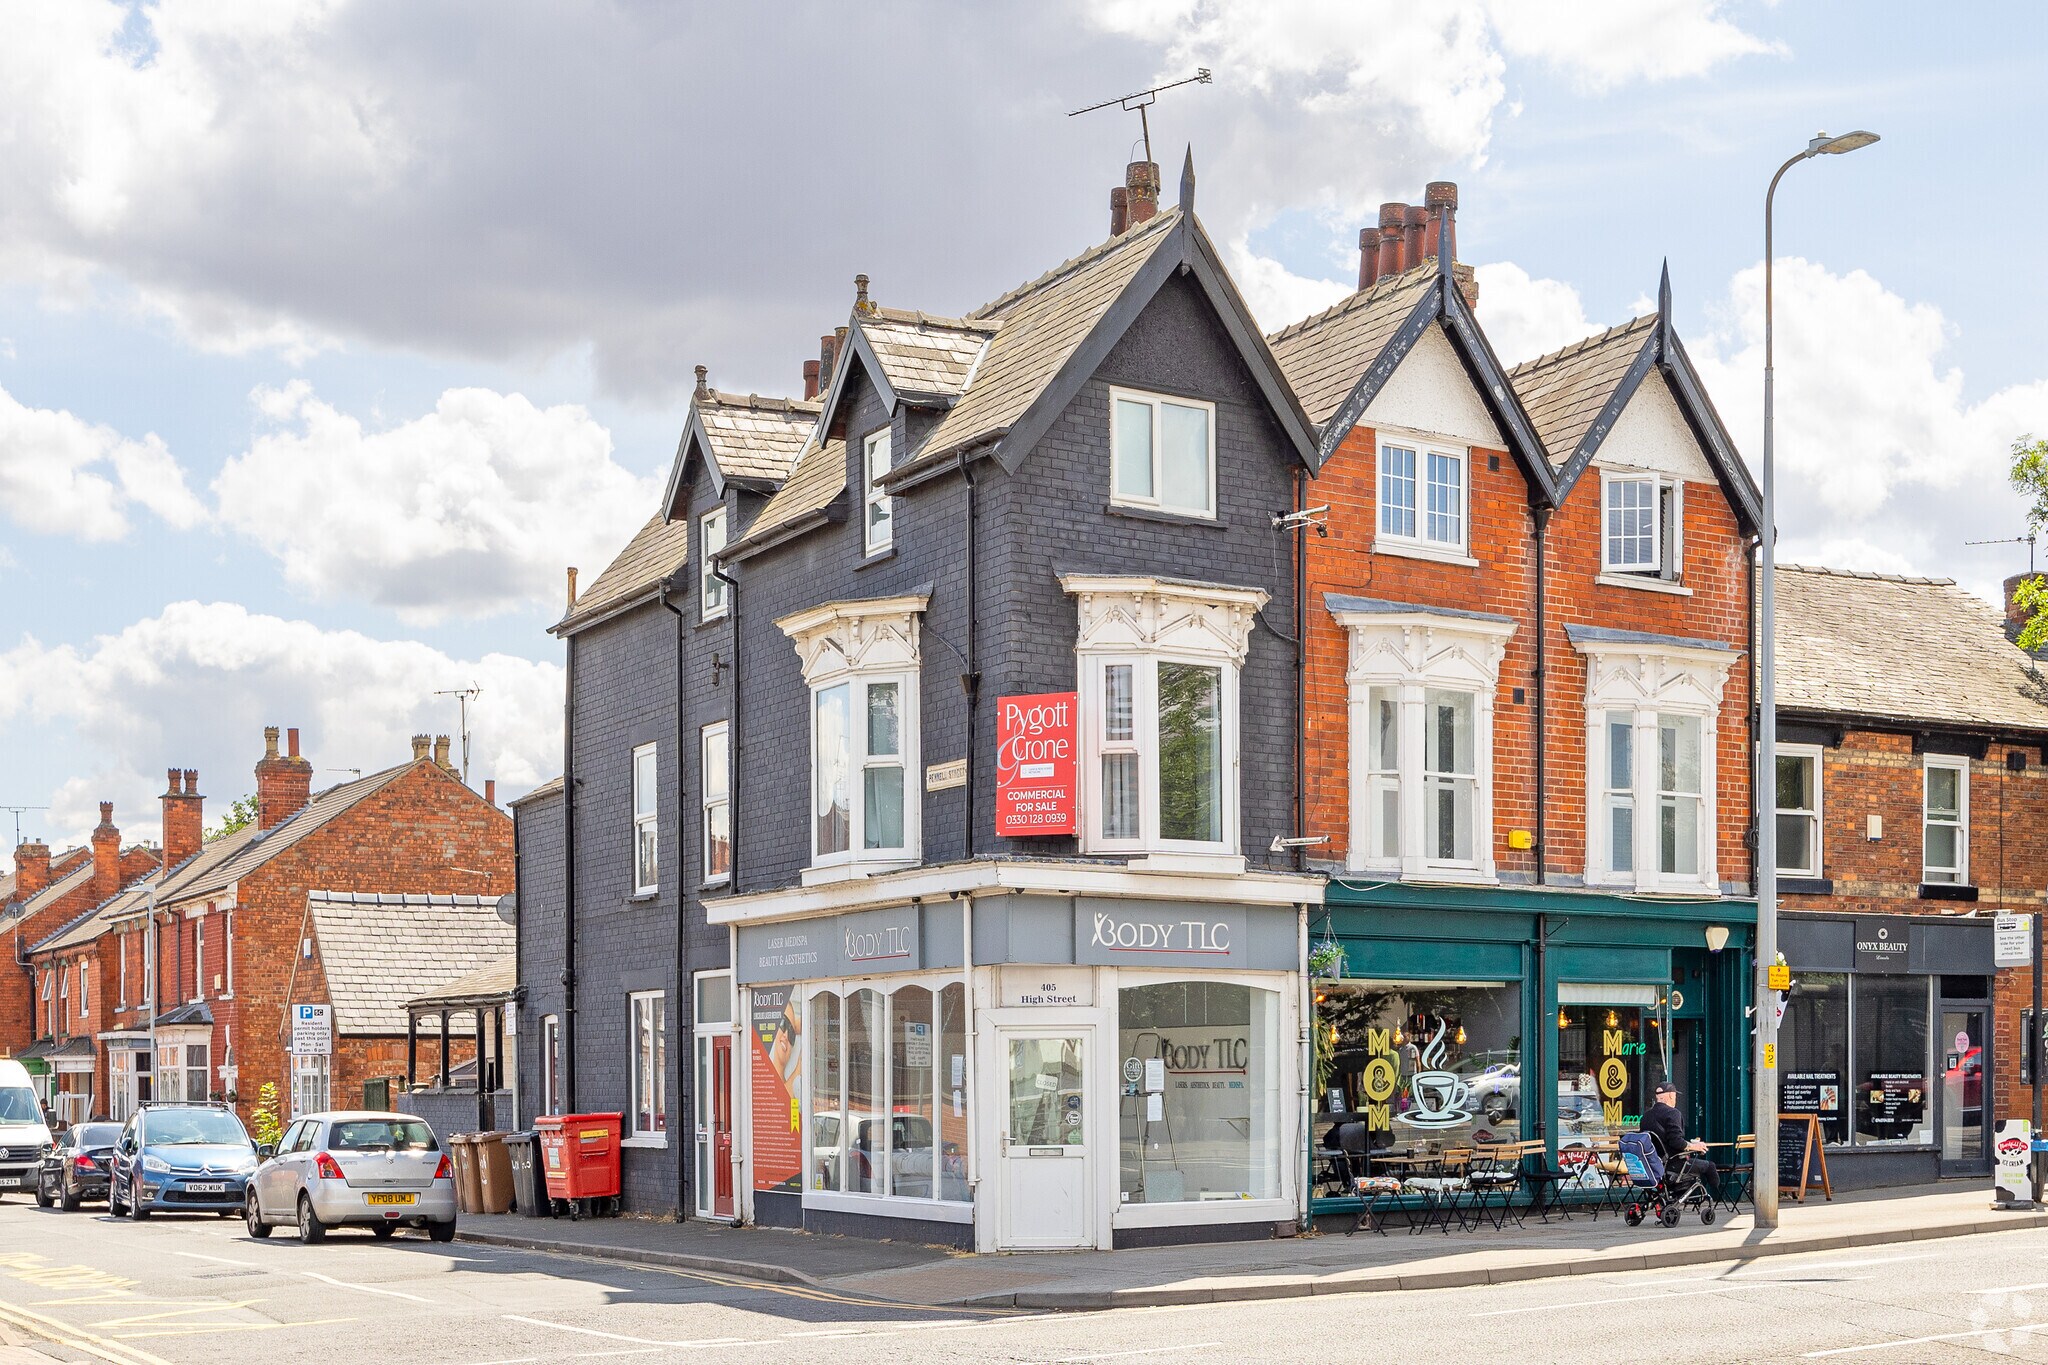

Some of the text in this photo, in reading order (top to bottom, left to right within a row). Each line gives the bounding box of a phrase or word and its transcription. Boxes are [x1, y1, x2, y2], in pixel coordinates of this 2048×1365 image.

[1006, 702, 1069, 735] Pygott
[1012, 736, 1069, 761] Crone
[1007, 790, 1066, 801] COMMERCIAL
[1016, 802, 1057, 812] FOR SALE
[1006, 813, 1067, 825] 0330 128 0939
[1091, 911, 1230, 950] BODY TLC
[767, 935, 808, 949] LASER MEDISPA
[844, 926, 911, 959] BODY TLC
[1857, 941, 1908, 951] ONYX BEAUTY
[759, 952, 818, 967] BEAUTY & AESTHETICS
[1041, 983, 1057, 991] 405
[754, 991, 784, 1007] BODY TLC
[1021, 994, 1077, 1005] High Street
[1603, 1030, 1647, 1056] Marie
[1161, 1037, 1248, 1070] BODY TLC
[1126, 1061, 1140, 1069] Gift
[1036, 1079, 1056, 1088] CLOSED
[2009, 1159, 2024, 1167] CREAM
[371, 1193, 393, 1203] YF08
